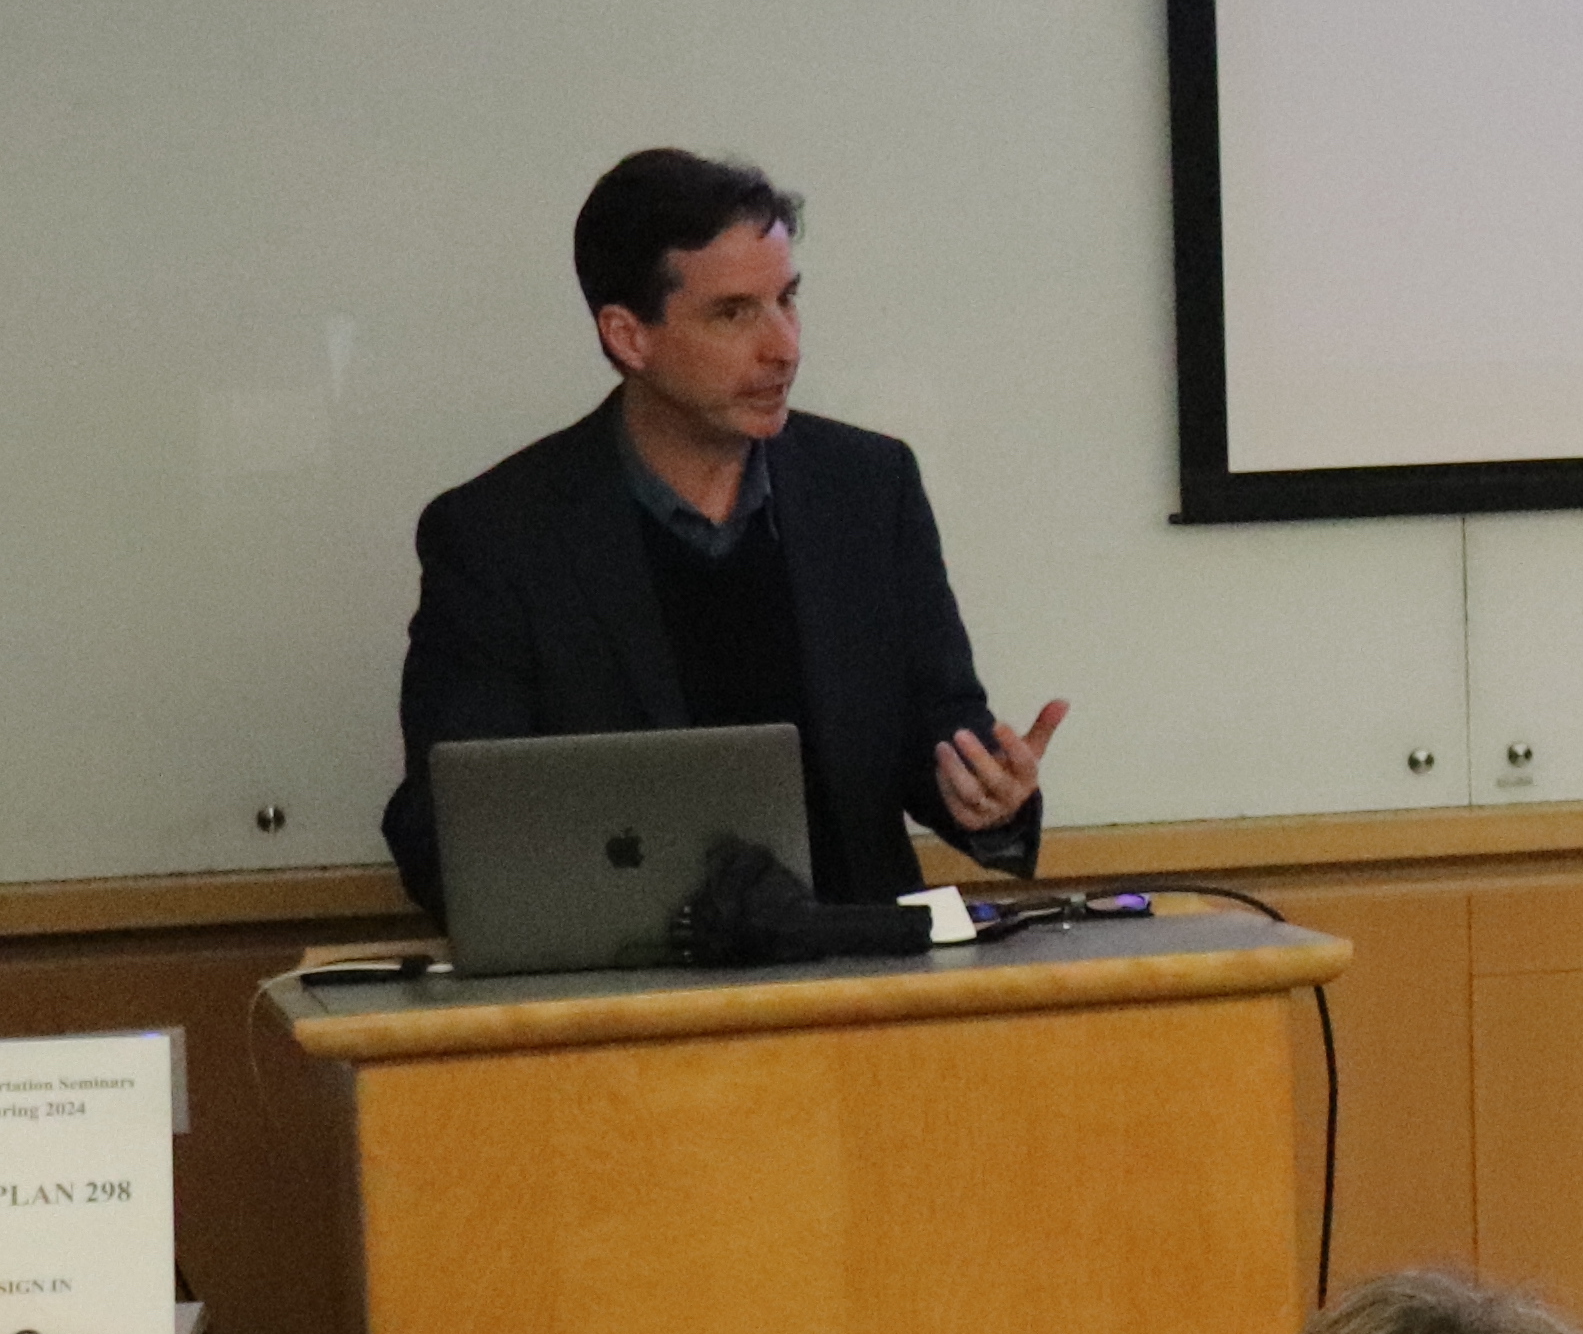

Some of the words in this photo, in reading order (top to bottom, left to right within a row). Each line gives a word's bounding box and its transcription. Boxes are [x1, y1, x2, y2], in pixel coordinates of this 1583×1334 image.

[0, 1104, 39, 1122] ring
[46, 1102, 86, 1117] 2024
[86, 1180, 131, 1203] 298
